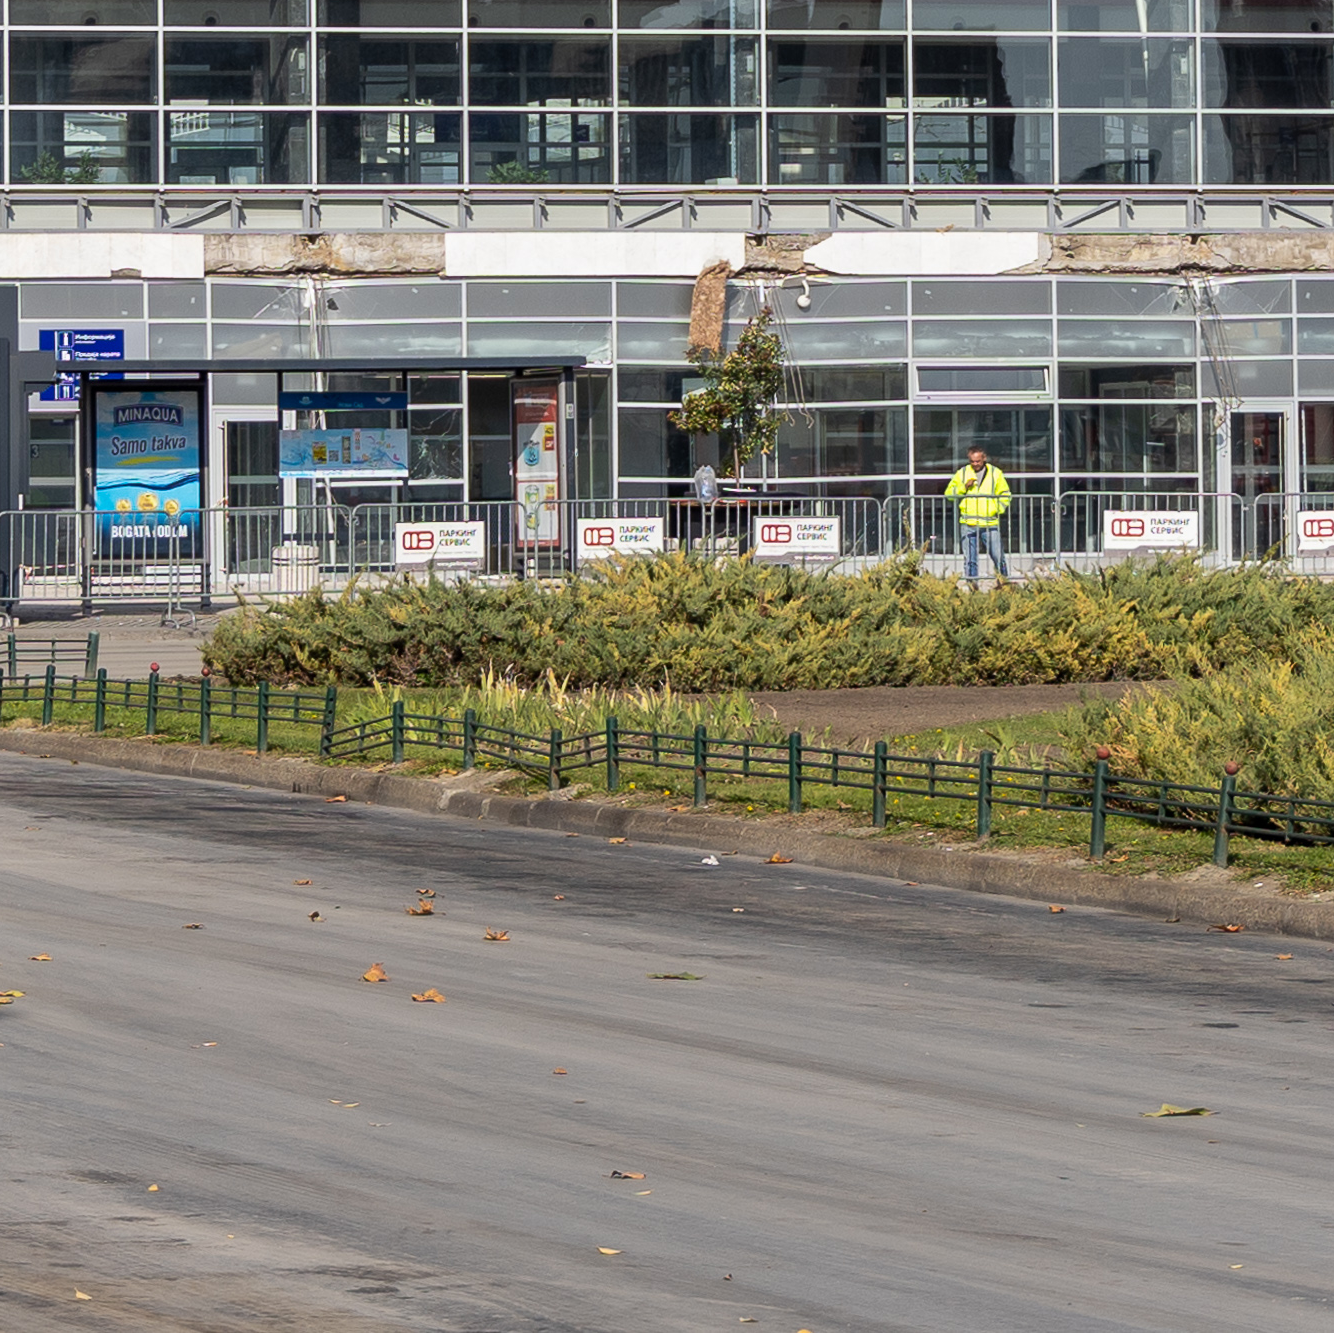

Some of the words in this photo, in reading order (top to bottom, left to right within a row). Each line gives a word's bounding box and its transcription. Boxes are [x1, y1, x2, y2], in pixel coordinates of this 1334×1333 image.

[118, 406, 179, 423] MINAQUA
[111, 436, 147, 456] Samo
[151, 434, 187, 451] takva
[111, 525, 151, 538] BOGATA
[619, 525, 655, 533] ПАРКИНГ
[796, 524, 833, 532] ПАРКИНГ
[439, 529, 477, 537] ПАРКИНГ
[796, 532, 827, 541] СЕРВИС
[439, 538, 471, 546] СЕРВИС
[619, 534, 649, 542] СЕРВИС
